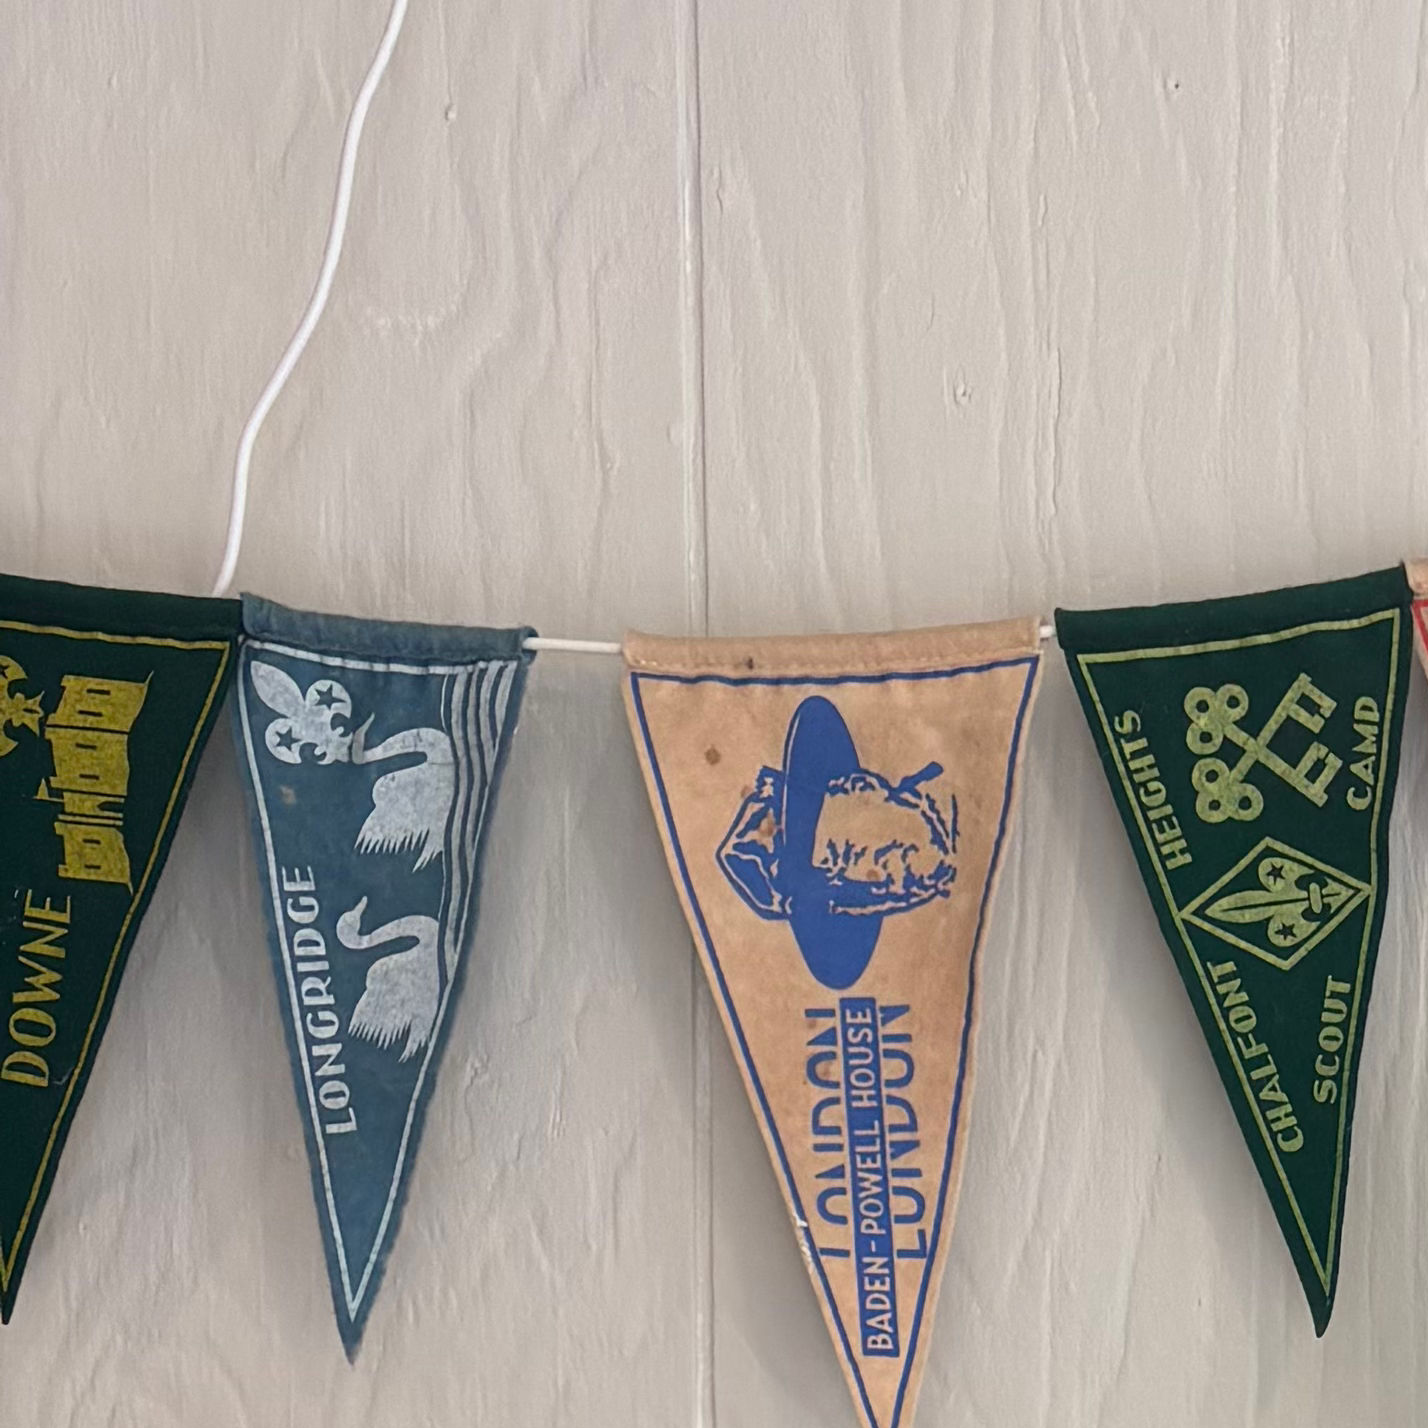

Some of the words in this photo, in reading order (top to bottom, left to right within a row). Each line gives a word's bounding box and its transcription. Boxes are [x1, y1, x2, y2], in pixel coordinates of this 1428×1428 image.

[1113, 709, 1193, 870] HEIGHTS
[1, 888, 71, 1088] DOWNE
[281, 865, 358, 1134] LONGRIDGE
[845, 1007, 877, 1108] HOUSE
[1206, 960, 1304, 1153] CHALFONT
[1313, 975, 1352, 1105] SCOUT
